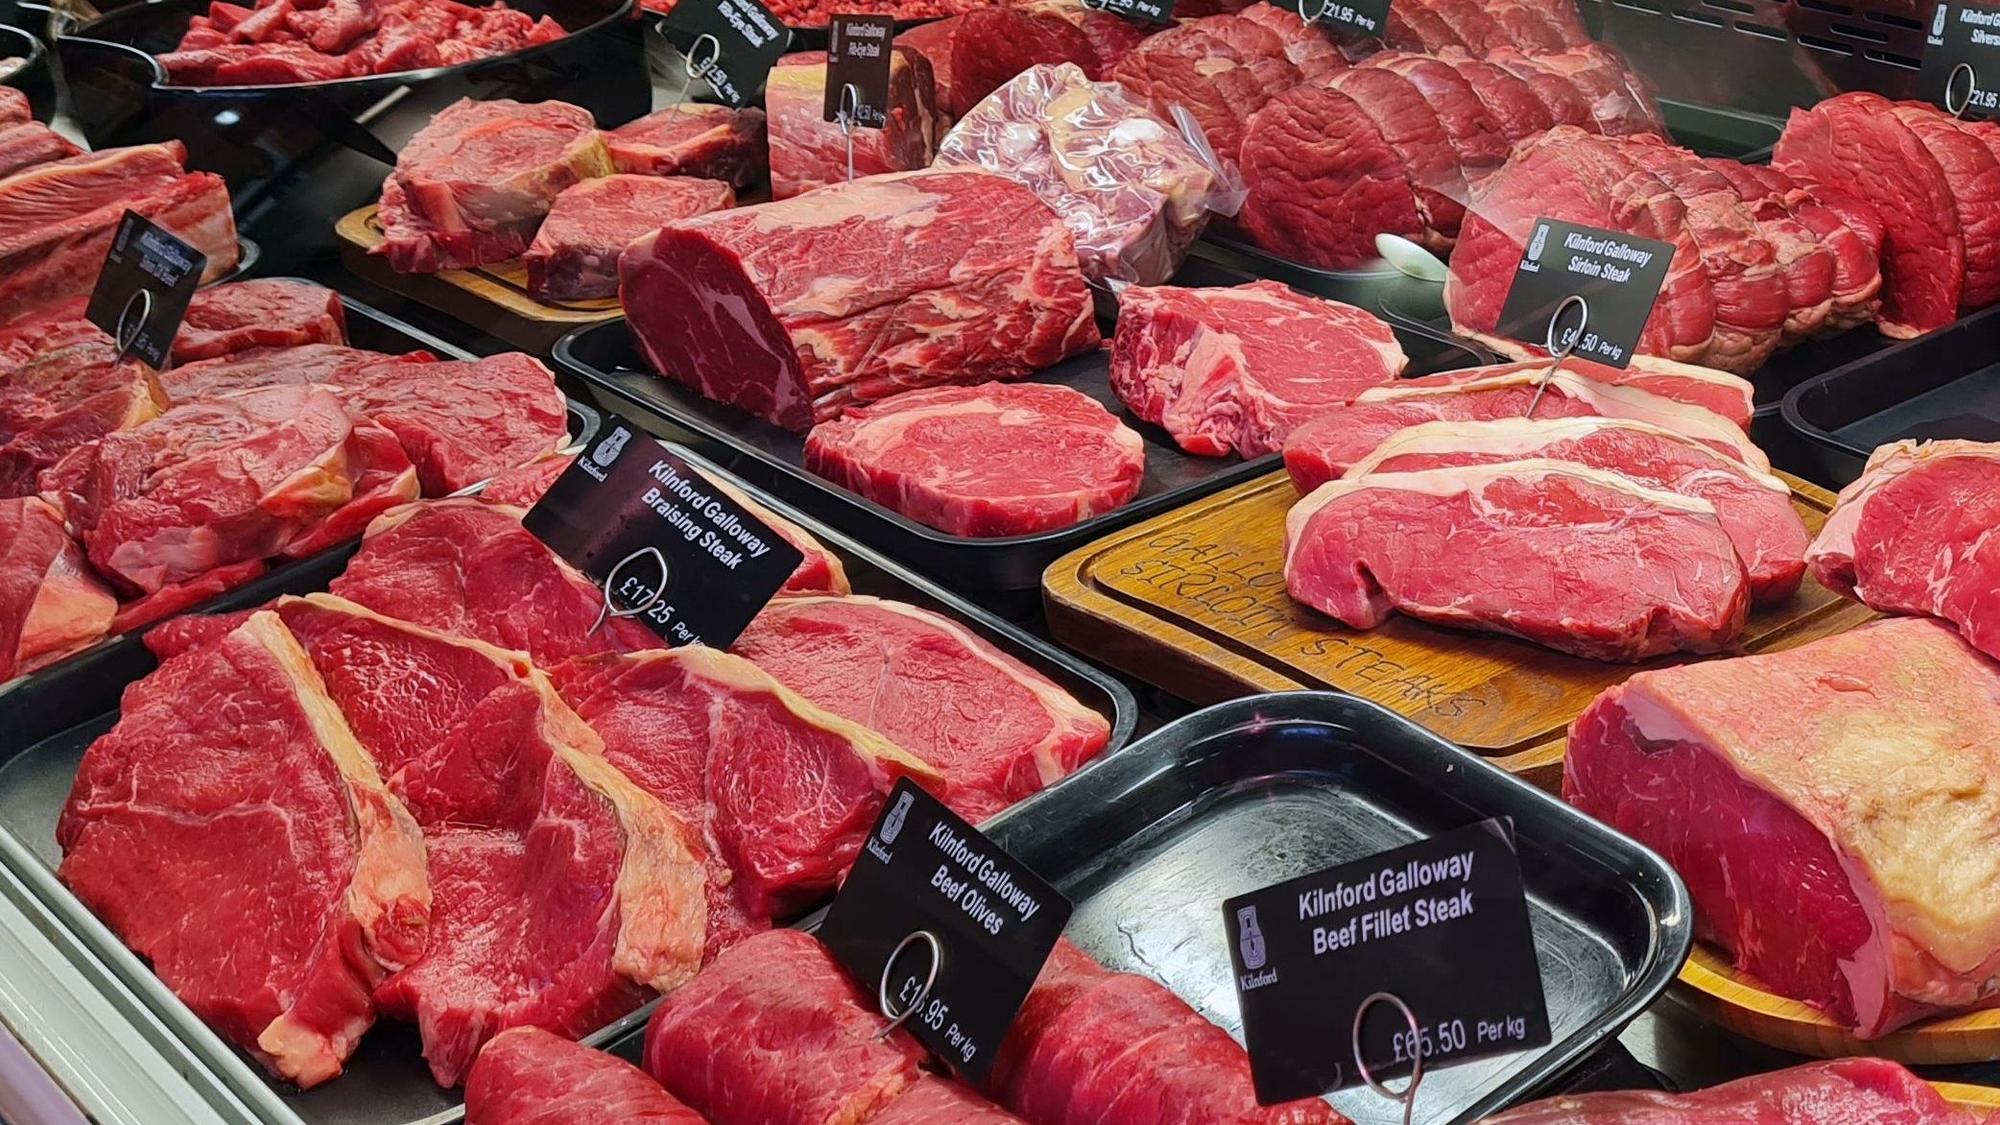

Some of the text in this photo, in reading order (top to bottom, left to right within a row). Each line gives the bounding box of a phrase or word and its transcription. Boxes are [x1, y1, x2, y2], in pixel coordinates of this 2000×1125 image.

[1564, 232, 1653, 268] Kilnford Galloway
[1568, 256, 1631, 282] Sirloin Steak
[1560, 327, 1623, 360] £4.50 Per kg
[577, 454, 608, 483] Kilnford
[641, 487, 744, 570] Braising Steak
[648, 460, 770, 559] Kilnford Galloway
[1148, 533, 1288, 597] GALLO
[671, 621, 694, 642] Per
[1300, 638, 1487, 717] STEAKS
[866, 836, 893, 864] Kilnford
[928, 820, 1040, 922] Kilnford Galloway
[931, 864, 1004, 936] Beef Olives
[1299, 851, 1474, 920] Kilnford Galloway
[1313, 888, 1473, 955] Beef Fillet Steak
[1240, 968, 1278, 991] Kilnford
[944, 1022, 966, 1048] Per
[960, 1037, 977, 1063] kg
[1393, 1015, 1525, 1062] £65.50 Per kg
